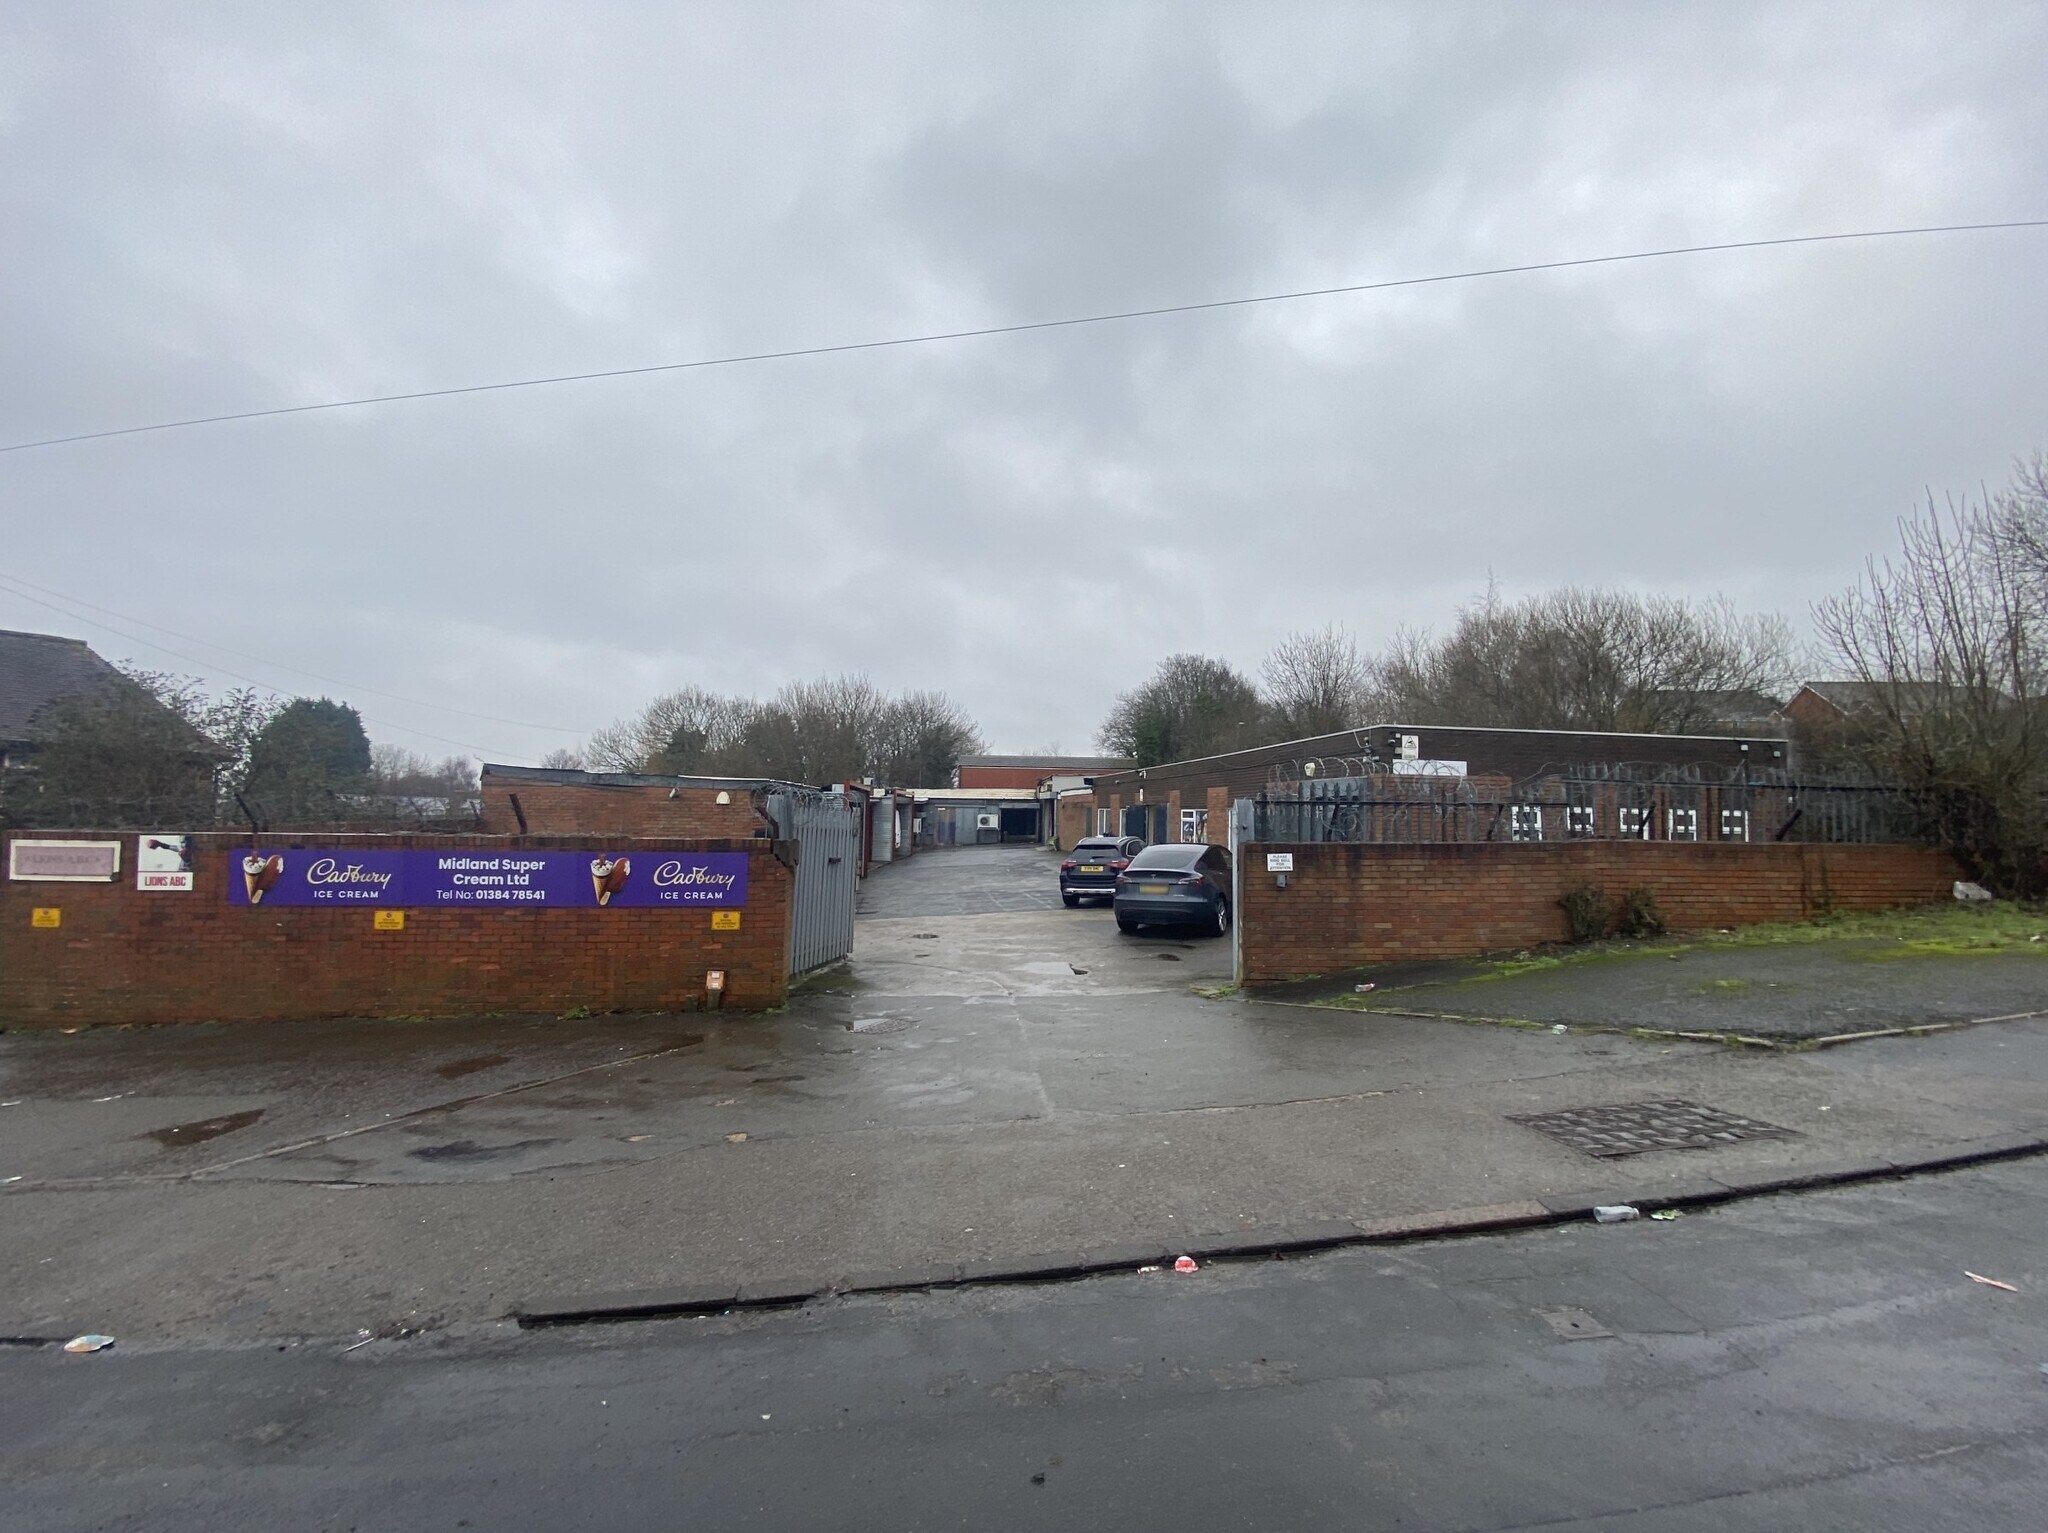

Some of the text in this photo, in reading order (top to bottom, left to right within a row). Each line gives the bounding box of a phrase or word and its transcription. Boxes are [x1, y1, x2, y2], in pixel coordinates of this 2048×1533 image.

[438, 857, 546, 874] Midland Super
[307, 858, 392, 889] Cadbury
[453, 873, 530, 885] Cream Ltd
[653, 860, 736, 891] Cadbury
[144, 876, 187, 886] LIONS ABC
[313, 890, 379, 898] ICE CREAM
[436, 889, 546, 900] Tel No: 01384 78541
[660, 891, 723, 899] ICE CREAM
